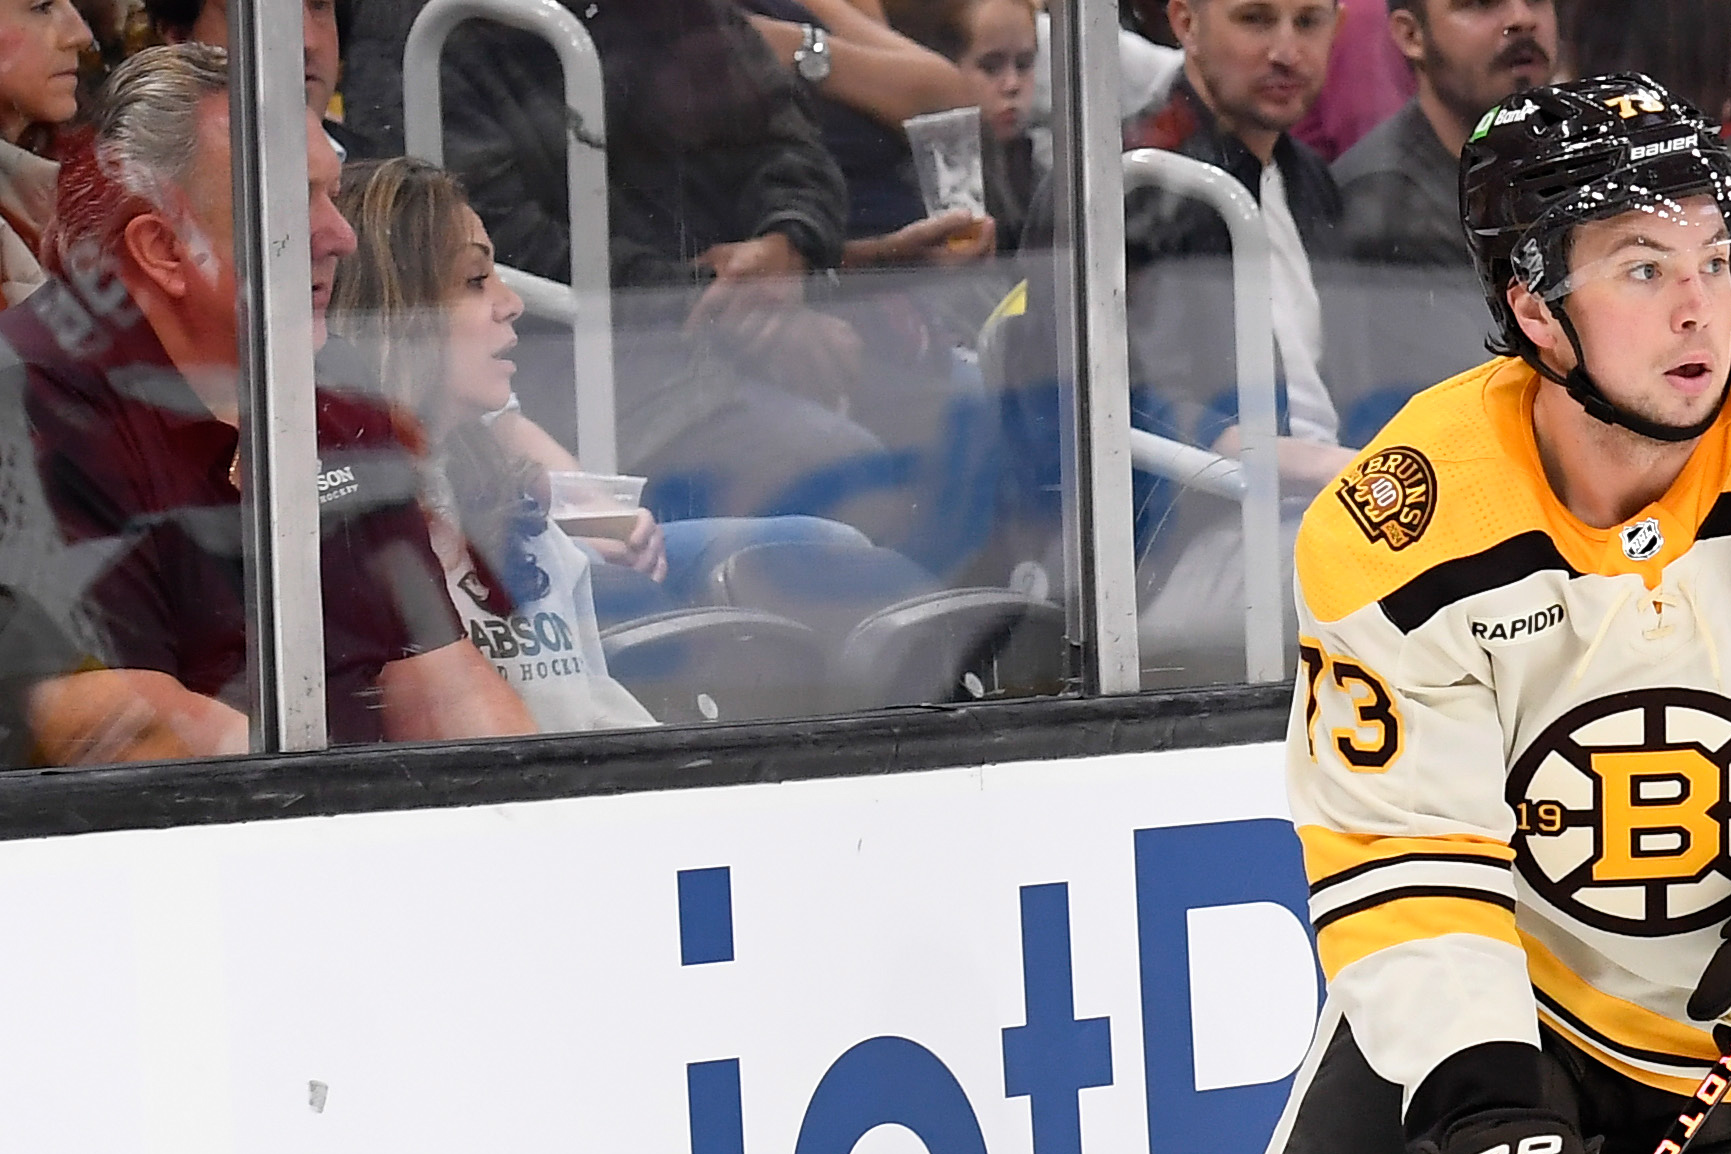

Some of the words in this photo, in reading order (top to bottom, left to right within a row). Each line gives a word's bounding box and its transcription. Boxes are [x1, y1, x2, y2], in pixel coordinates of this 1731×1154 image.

[1630, 134, 1698, 160] BAUER
[1364, 454, 1426, 525] BRUINS
[1371, 478, 1397, 507] 100
[1299, 634, 1405, 774] 73
[1517, 802, 1562, 832] 19
[1590, 749, 1721, 881] B
